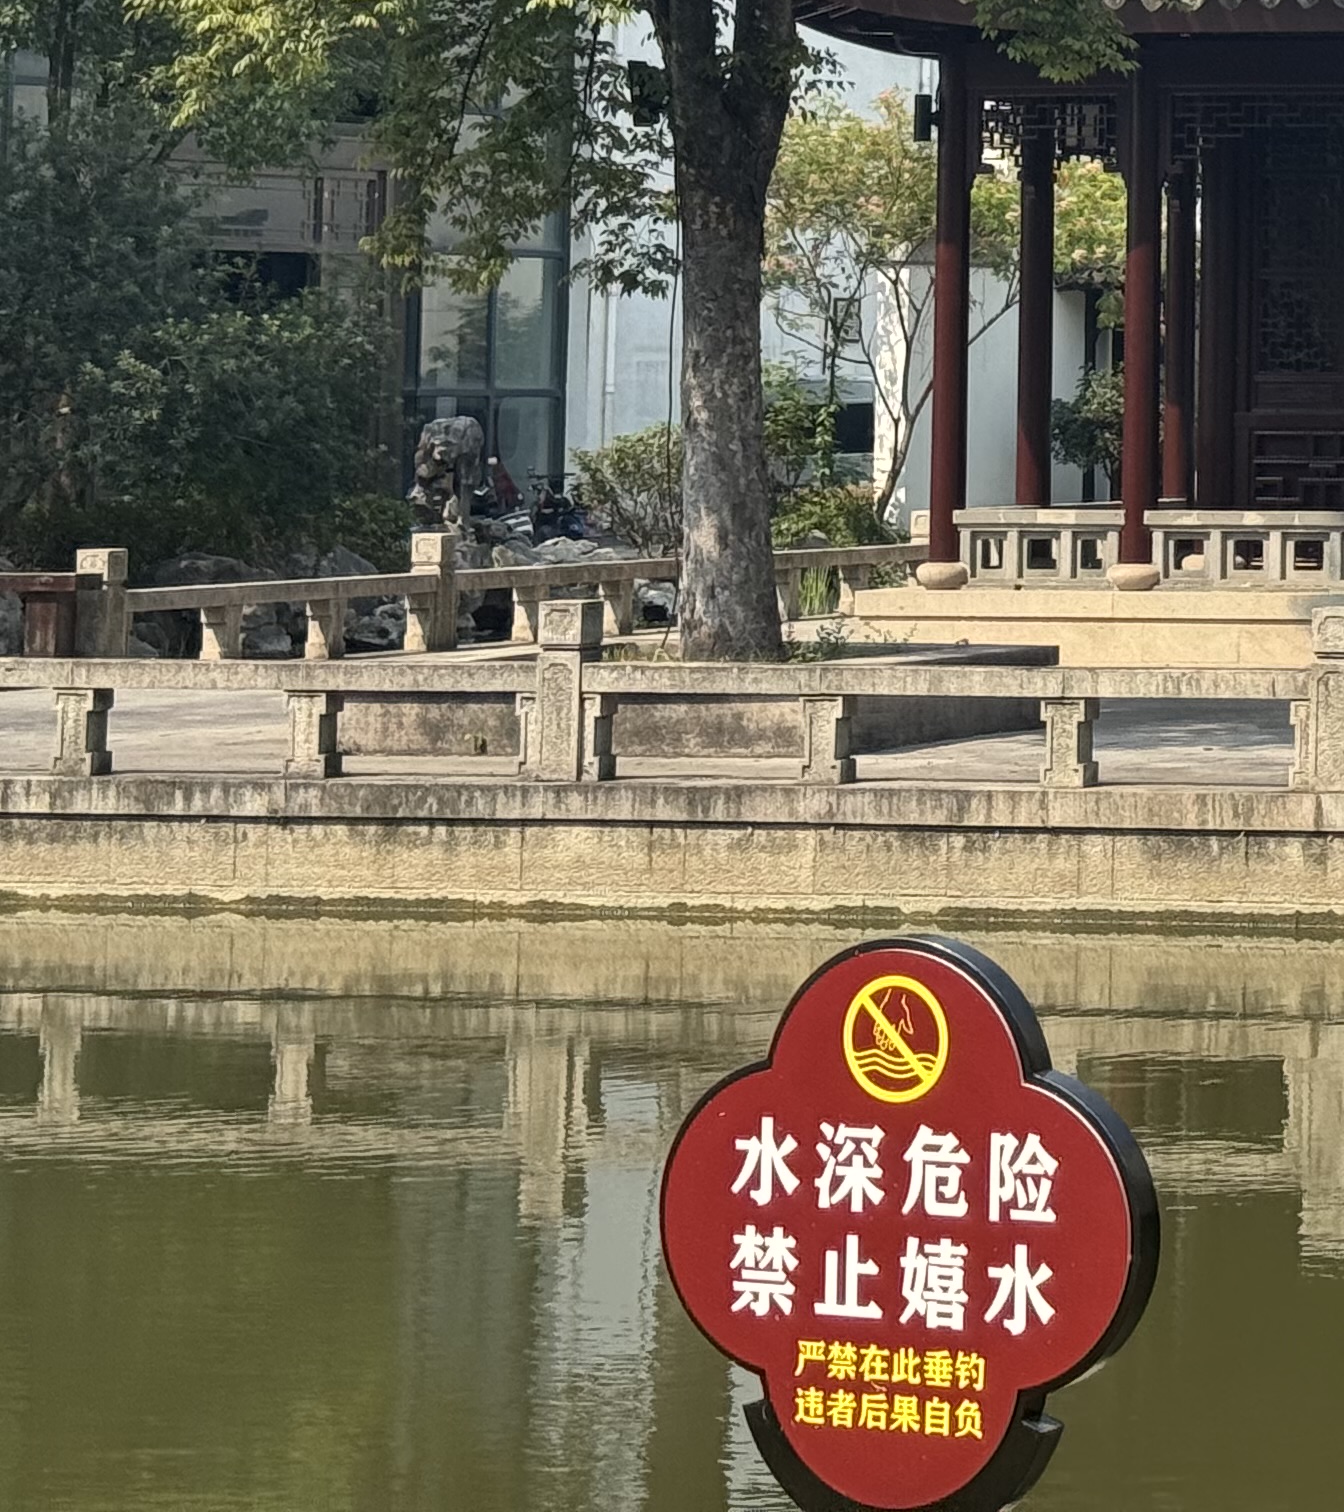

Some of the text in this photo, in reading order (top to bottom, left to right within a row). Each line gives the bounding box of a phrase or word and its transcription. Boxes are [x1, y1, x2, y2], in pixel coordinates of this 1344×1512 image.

[730, 1116, 1061, 1223] 水深危险
[730, 1224, 1057, 1336] 禁止嬉水
[794, 1340, 986, 1391] 严禁在此垂钓
[794, 1387, 985, 1439] 违者后果自负
